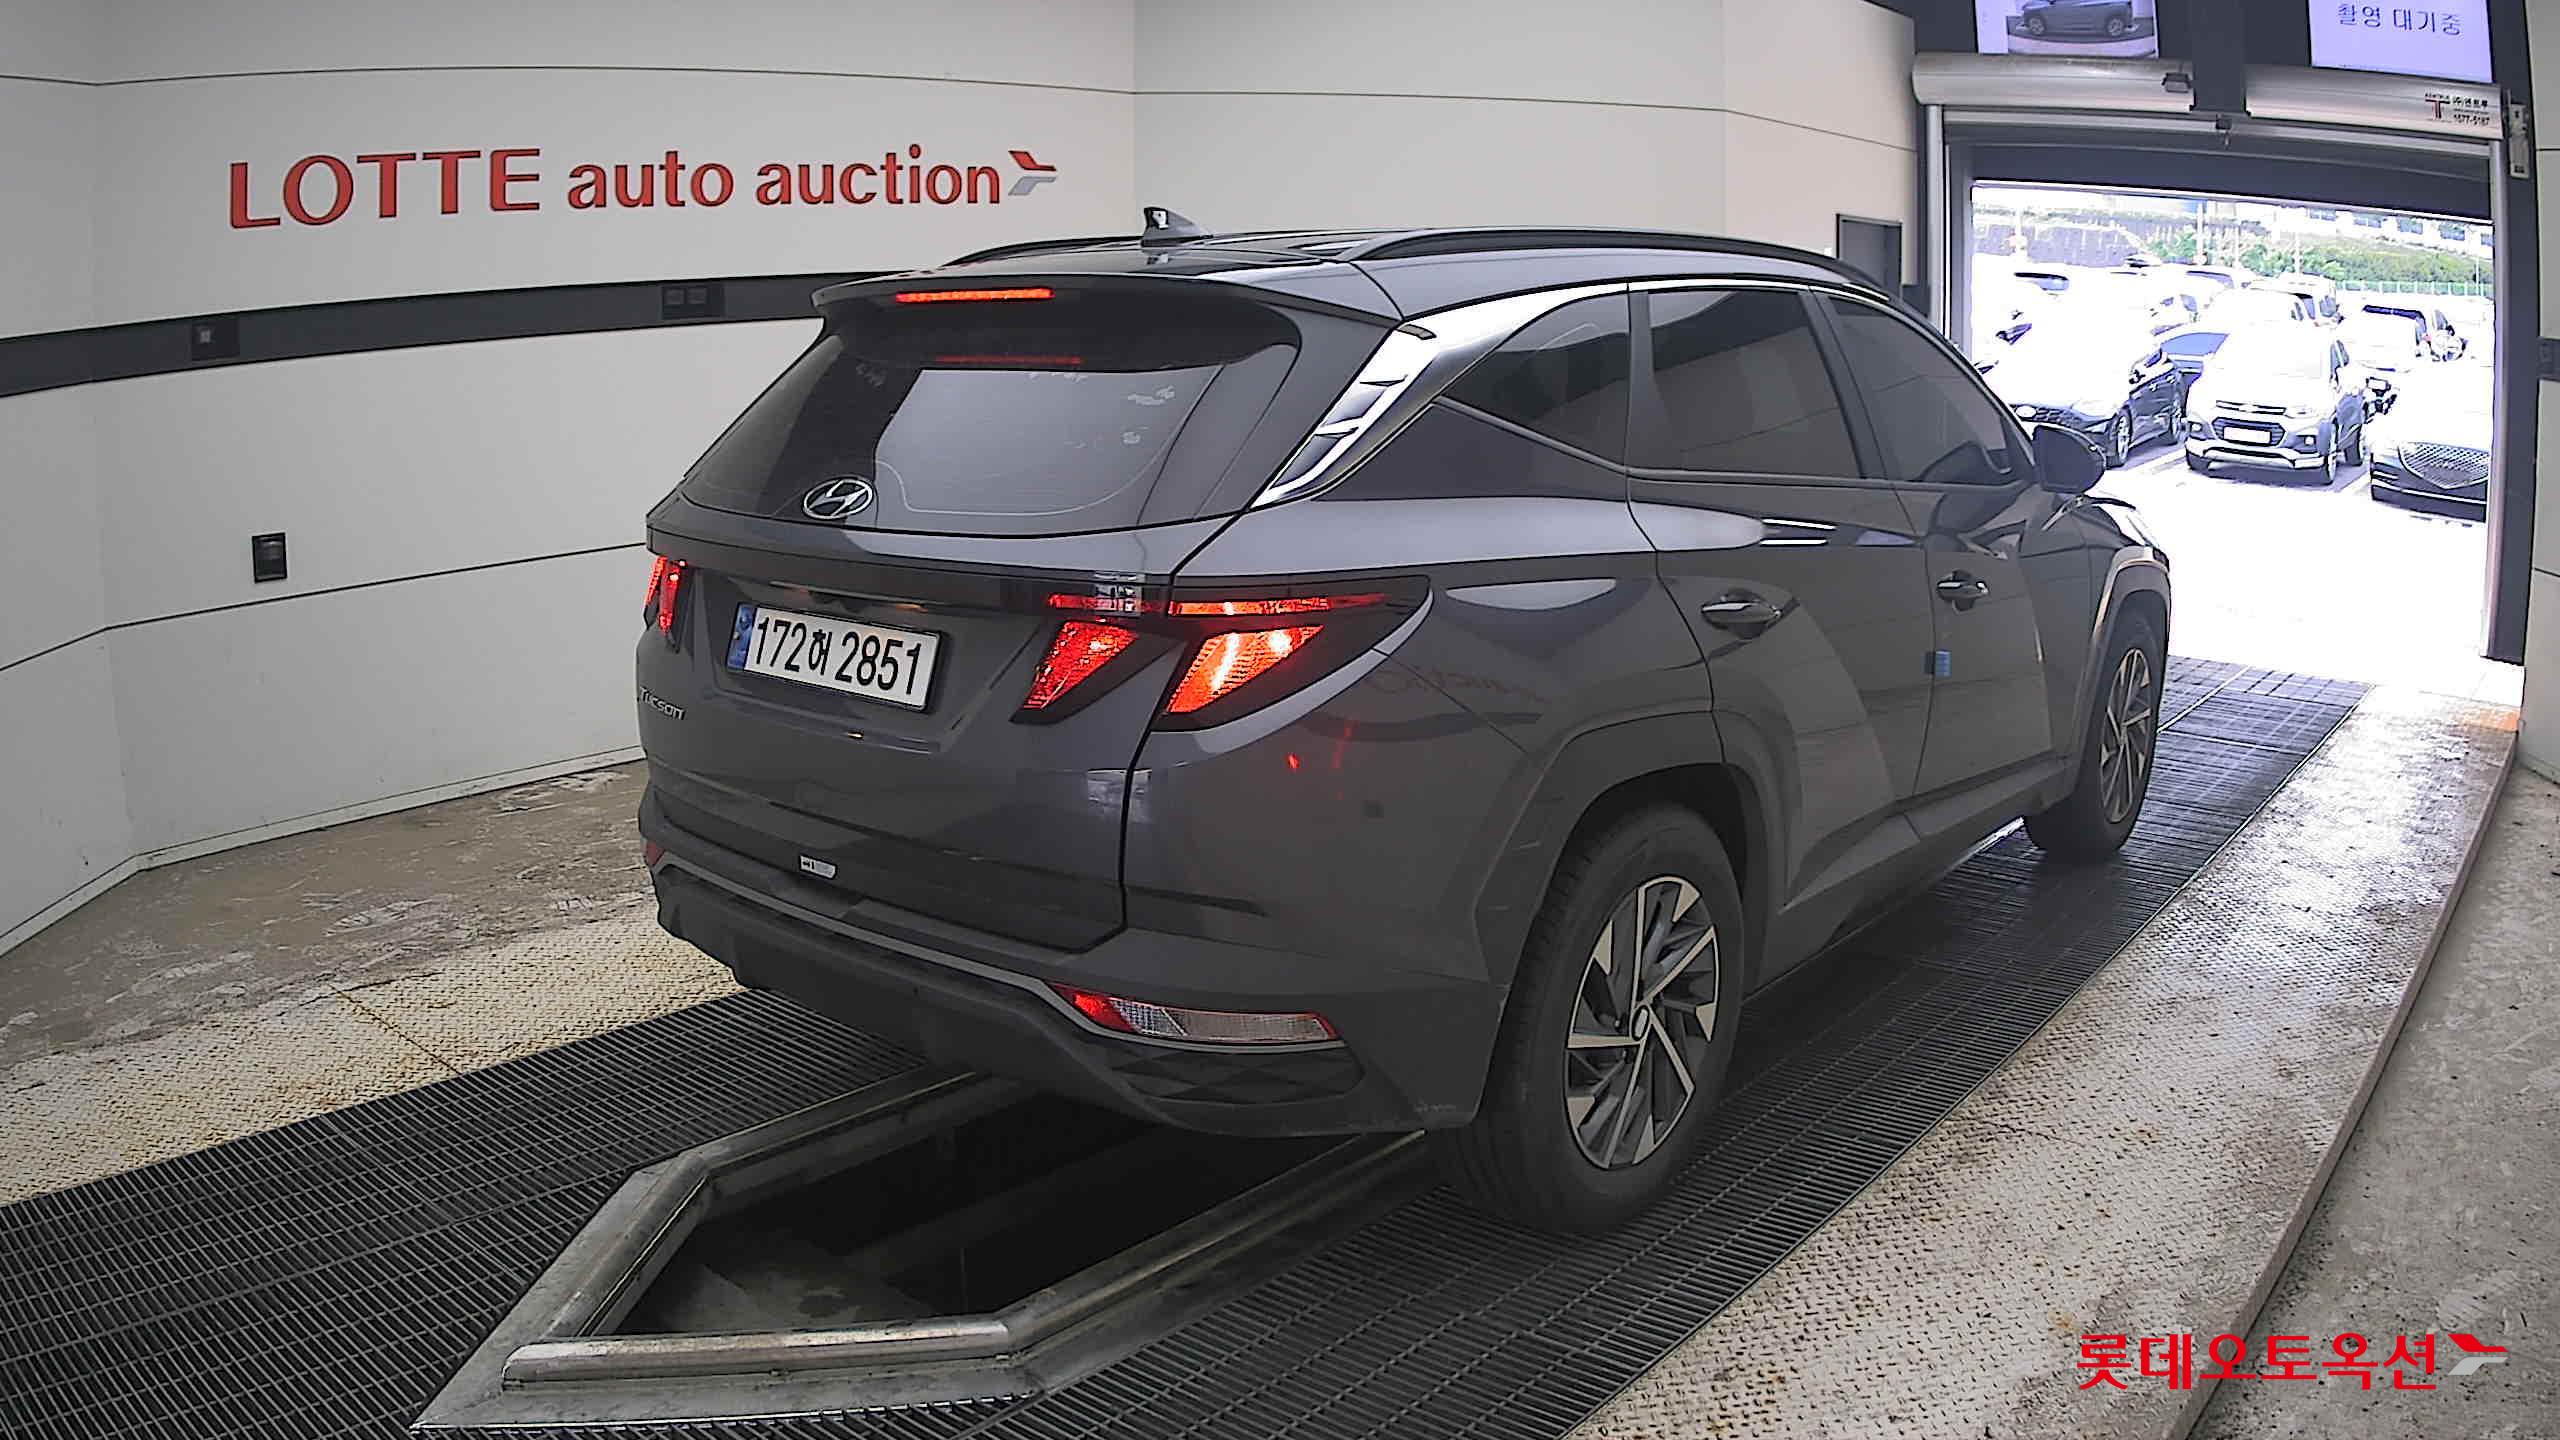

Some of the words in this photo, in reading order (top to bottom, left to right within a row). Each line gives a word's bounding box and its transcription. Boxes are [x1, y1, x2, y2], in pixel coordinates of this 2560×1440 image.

[2338, 4, 2381, 28] 촬영
[2393, 8, 2461, 36] 대기중
[230, 149, 540, 228] LOTTE
[568, 150, 735, 208] auto
[757, 146, 1001, 204] auction
[757, 616, 832, 676] 172허
[835, 631, 922, 695] 2851
